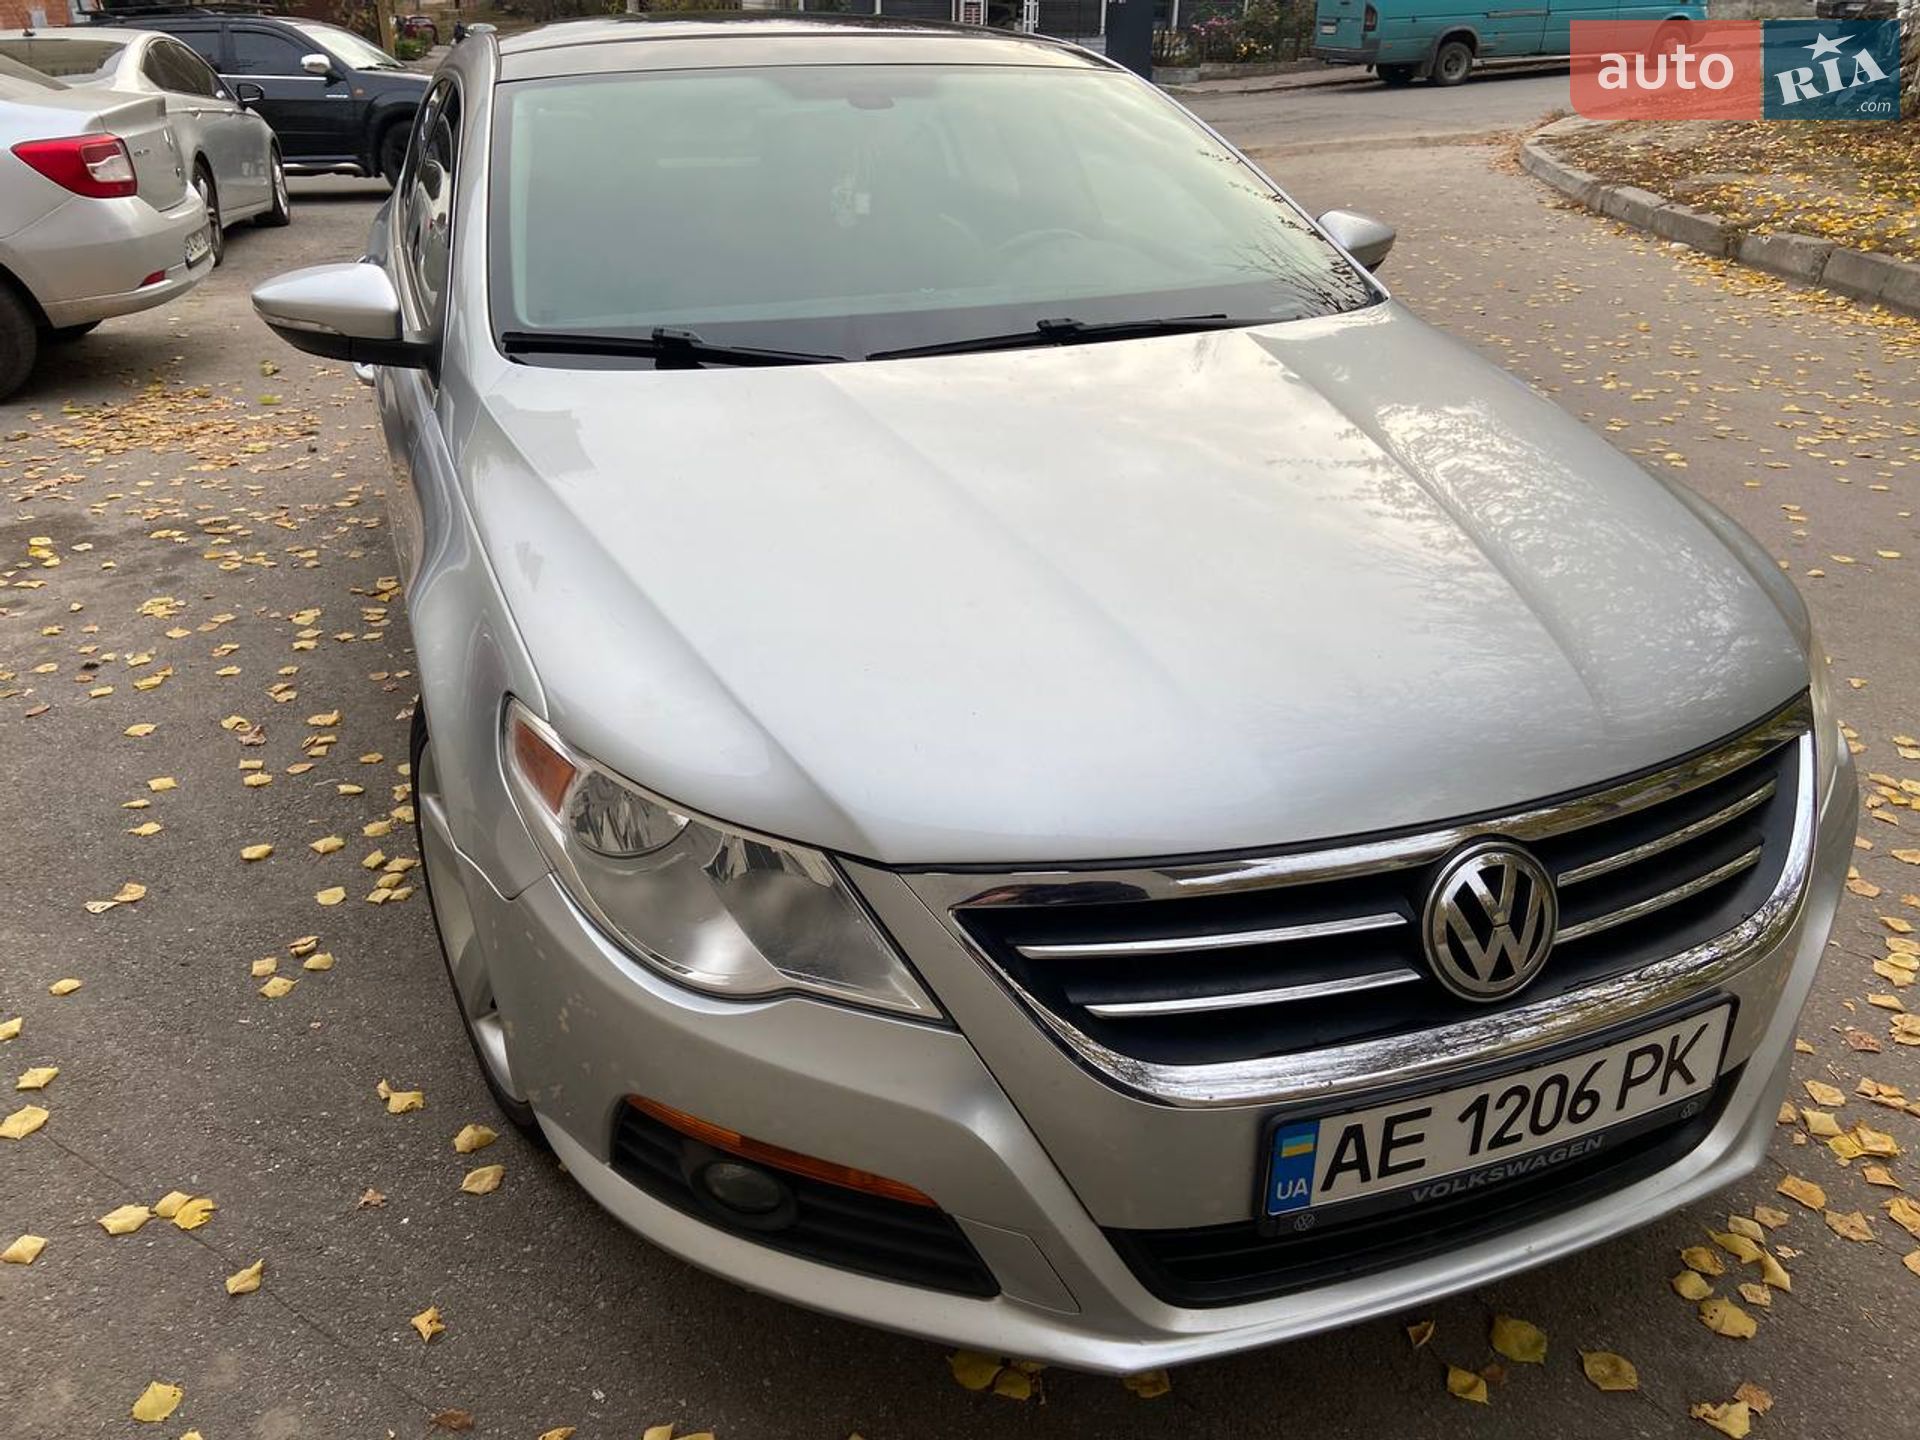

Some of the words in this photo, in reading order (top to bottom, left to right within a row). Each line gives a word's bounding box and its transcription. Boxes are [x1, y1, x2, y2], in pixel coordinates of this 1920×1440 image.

[1320, 1106, 1433, 1193] AE
[1457, 1058, 1608, 1157] 1206
[1615, 1022, 1708, 1112] PK
[1276, 1177, 1309, 1200] UA
[1410, 1134, 1603, 1203] VOLKSWAGEN
